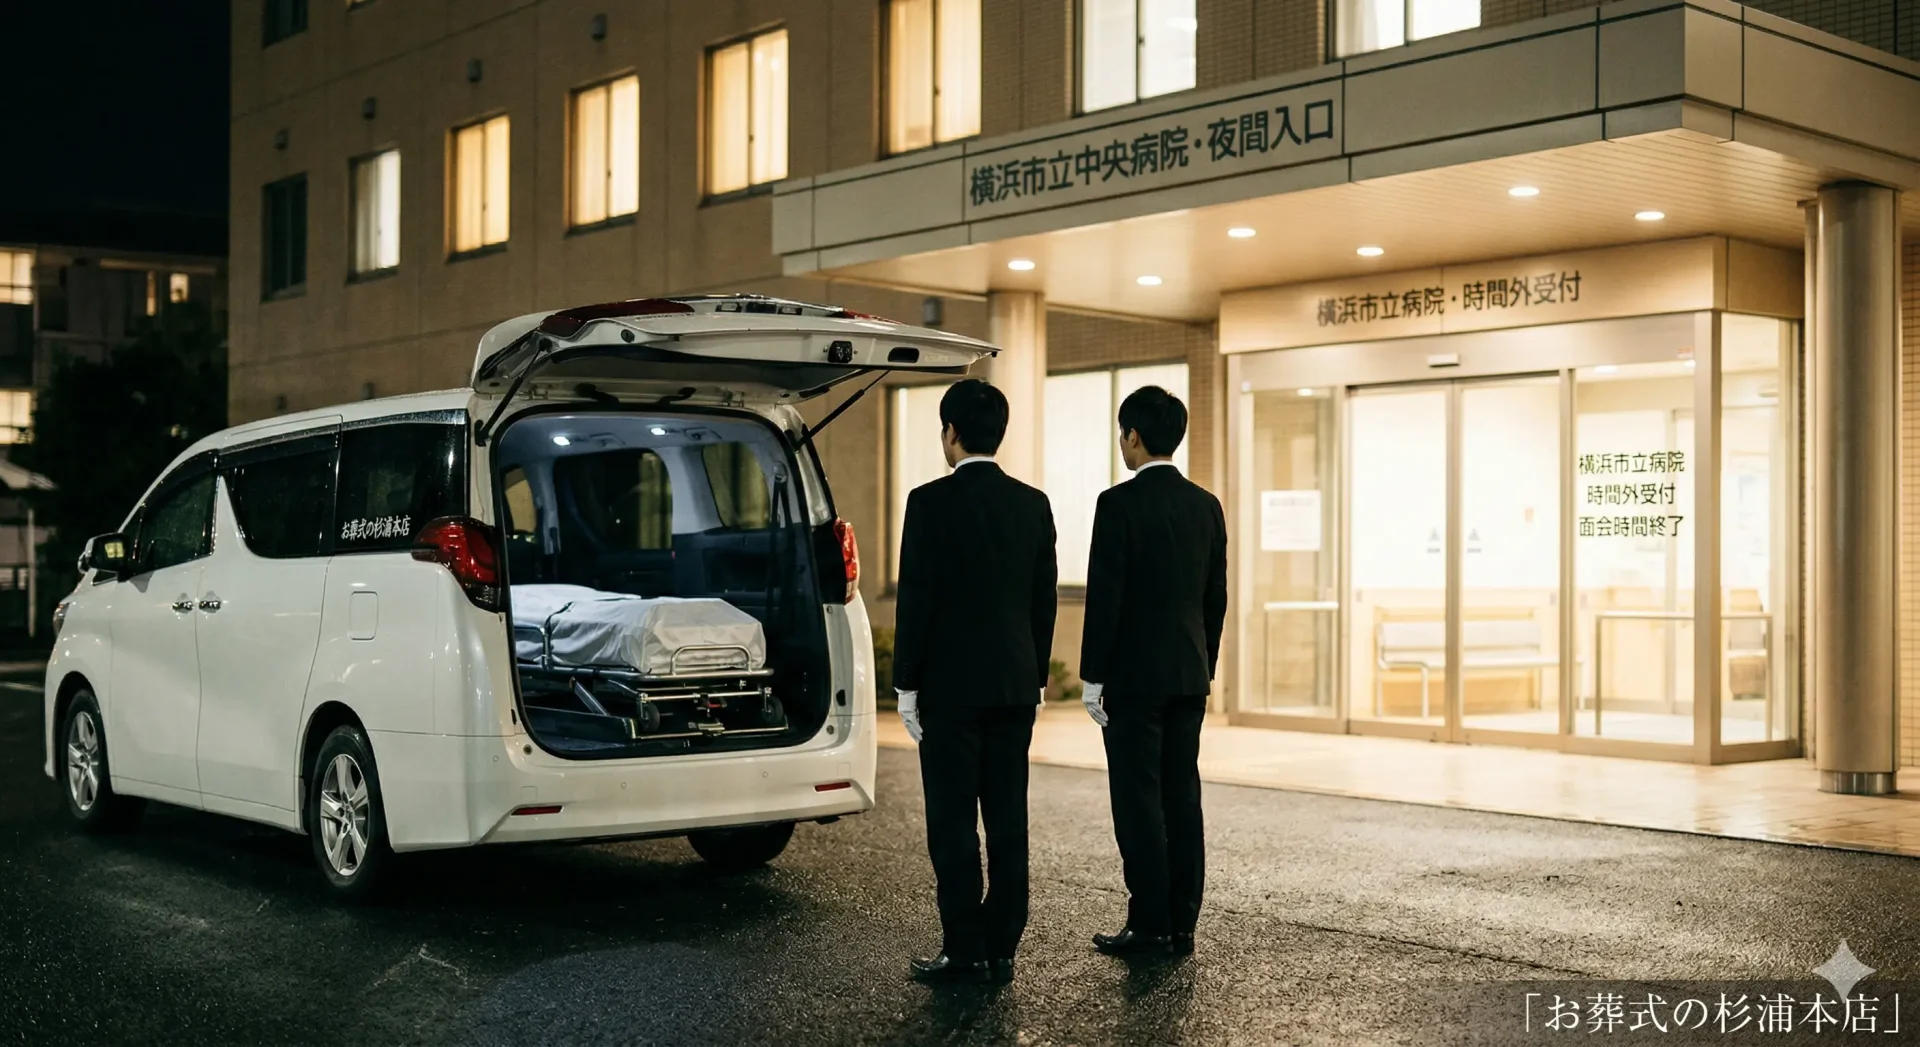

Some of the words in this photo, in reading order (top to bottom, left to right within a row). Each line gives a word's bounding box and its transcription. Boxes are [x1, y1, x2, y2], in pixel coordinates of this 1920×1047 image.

[969, 99, 1335, 207] 横浜市立中央病院・夜間入口
[1316, 270, 1582, 327] 横浜市立病院・時間外受付
[1579, 450, 1685, 475] 横浜市立病院
[1587, 482, 1676, 505] 時間外受付
[341, 514, 411, 541] お葬式の杉浦本店
[1579, 515, 1684, 537] 面会時間終了
